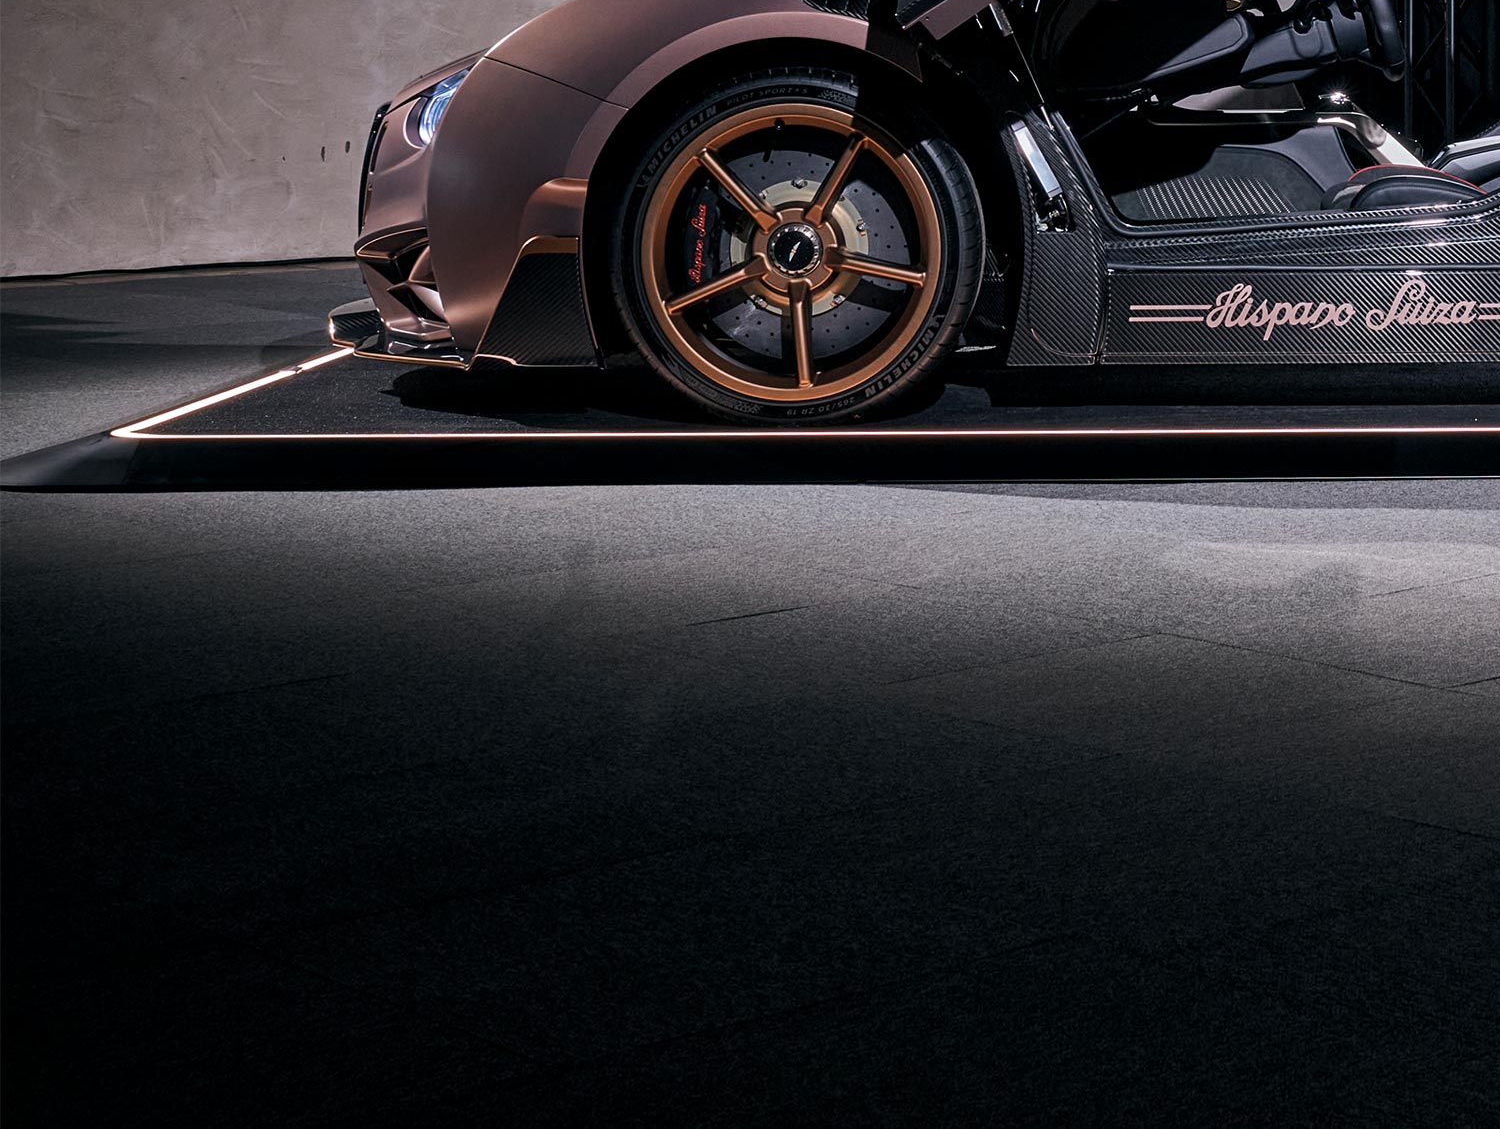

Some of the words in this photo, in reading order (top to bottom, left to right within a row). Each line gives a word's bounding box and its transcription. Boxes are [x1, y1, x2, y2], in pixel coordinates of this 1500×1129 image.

[648, 104, 719, 175] MICHELIN
[726, 92, 755, 107] PILOT
[758, 86, 793, 97] SPORT
[1206, 282, 1357, 341] Hispano
[1365, 277, 1478, 331] Suiza
[865, 329, 935, 398] MICHELIN
[801, 407, 816, 415] ZR
